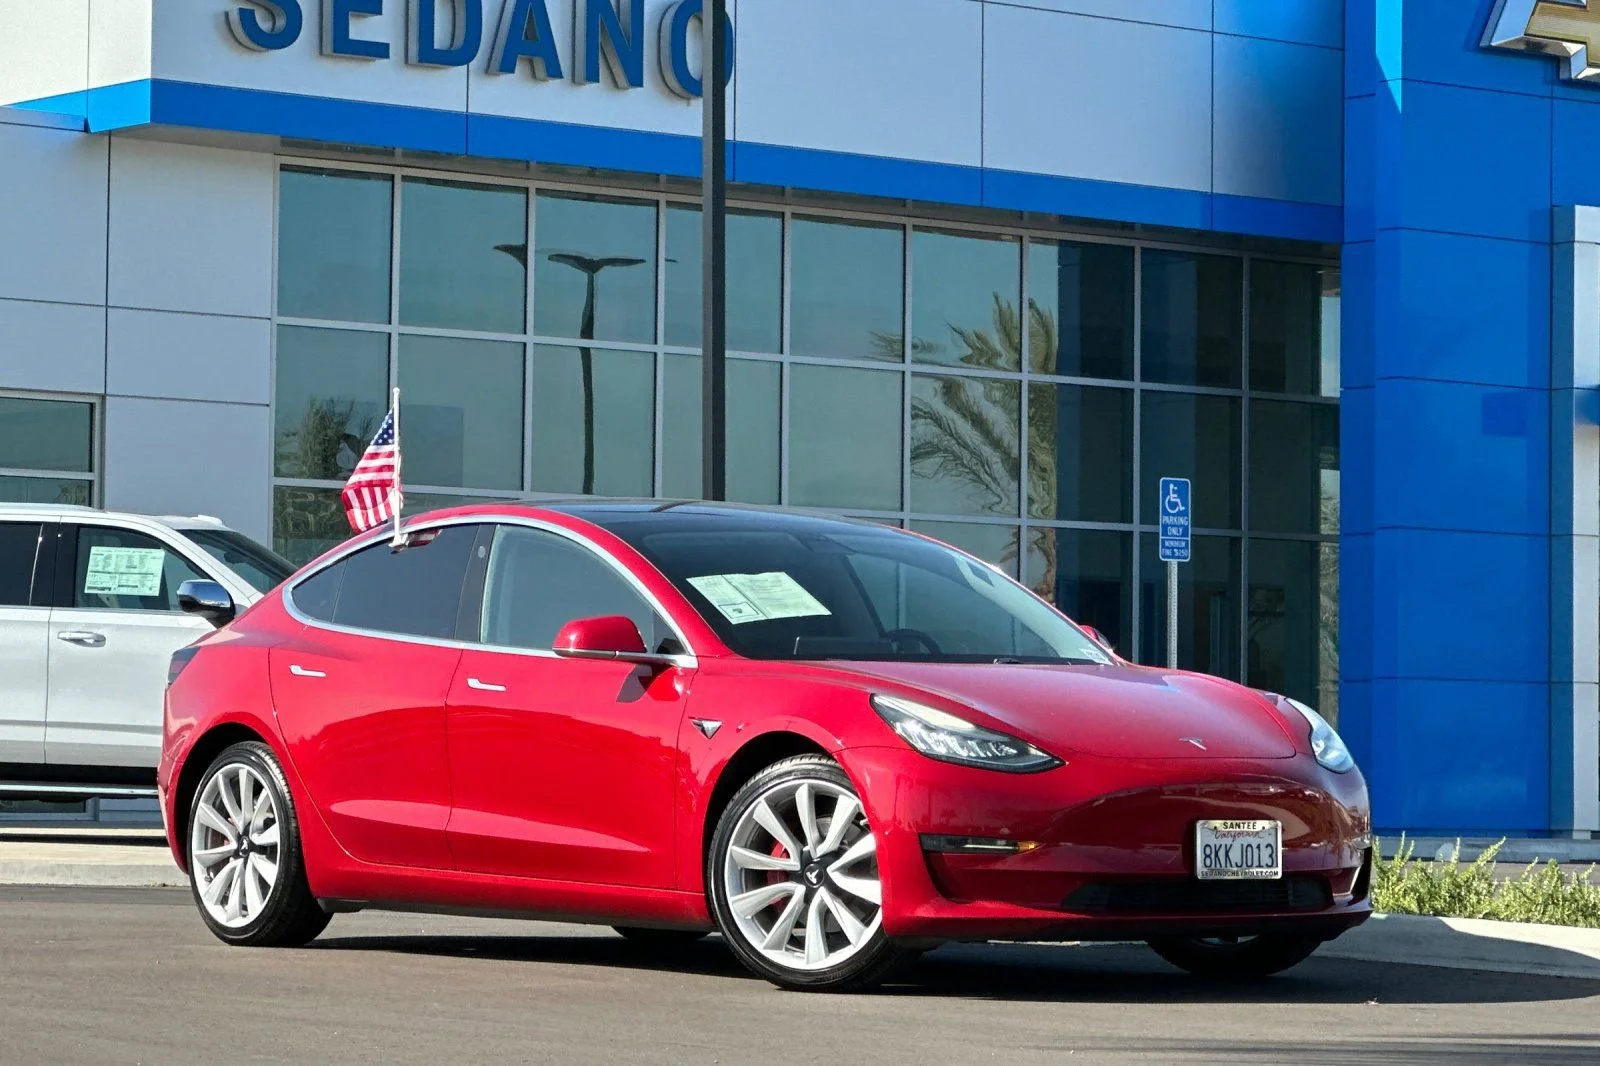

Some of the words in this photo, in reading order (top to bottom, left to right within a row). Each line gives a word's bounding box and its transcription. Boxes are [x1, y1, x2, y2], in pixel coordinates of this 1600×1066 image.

[1162, 516, 1188, 525] PARKING
[1167, 527, 1183, 535] ONLY
[1222, 821, 1257, 830] SANTEE
[1215, 831, 1264, 842] California
[1203, 843, 1274, 868] 8KKJ013
